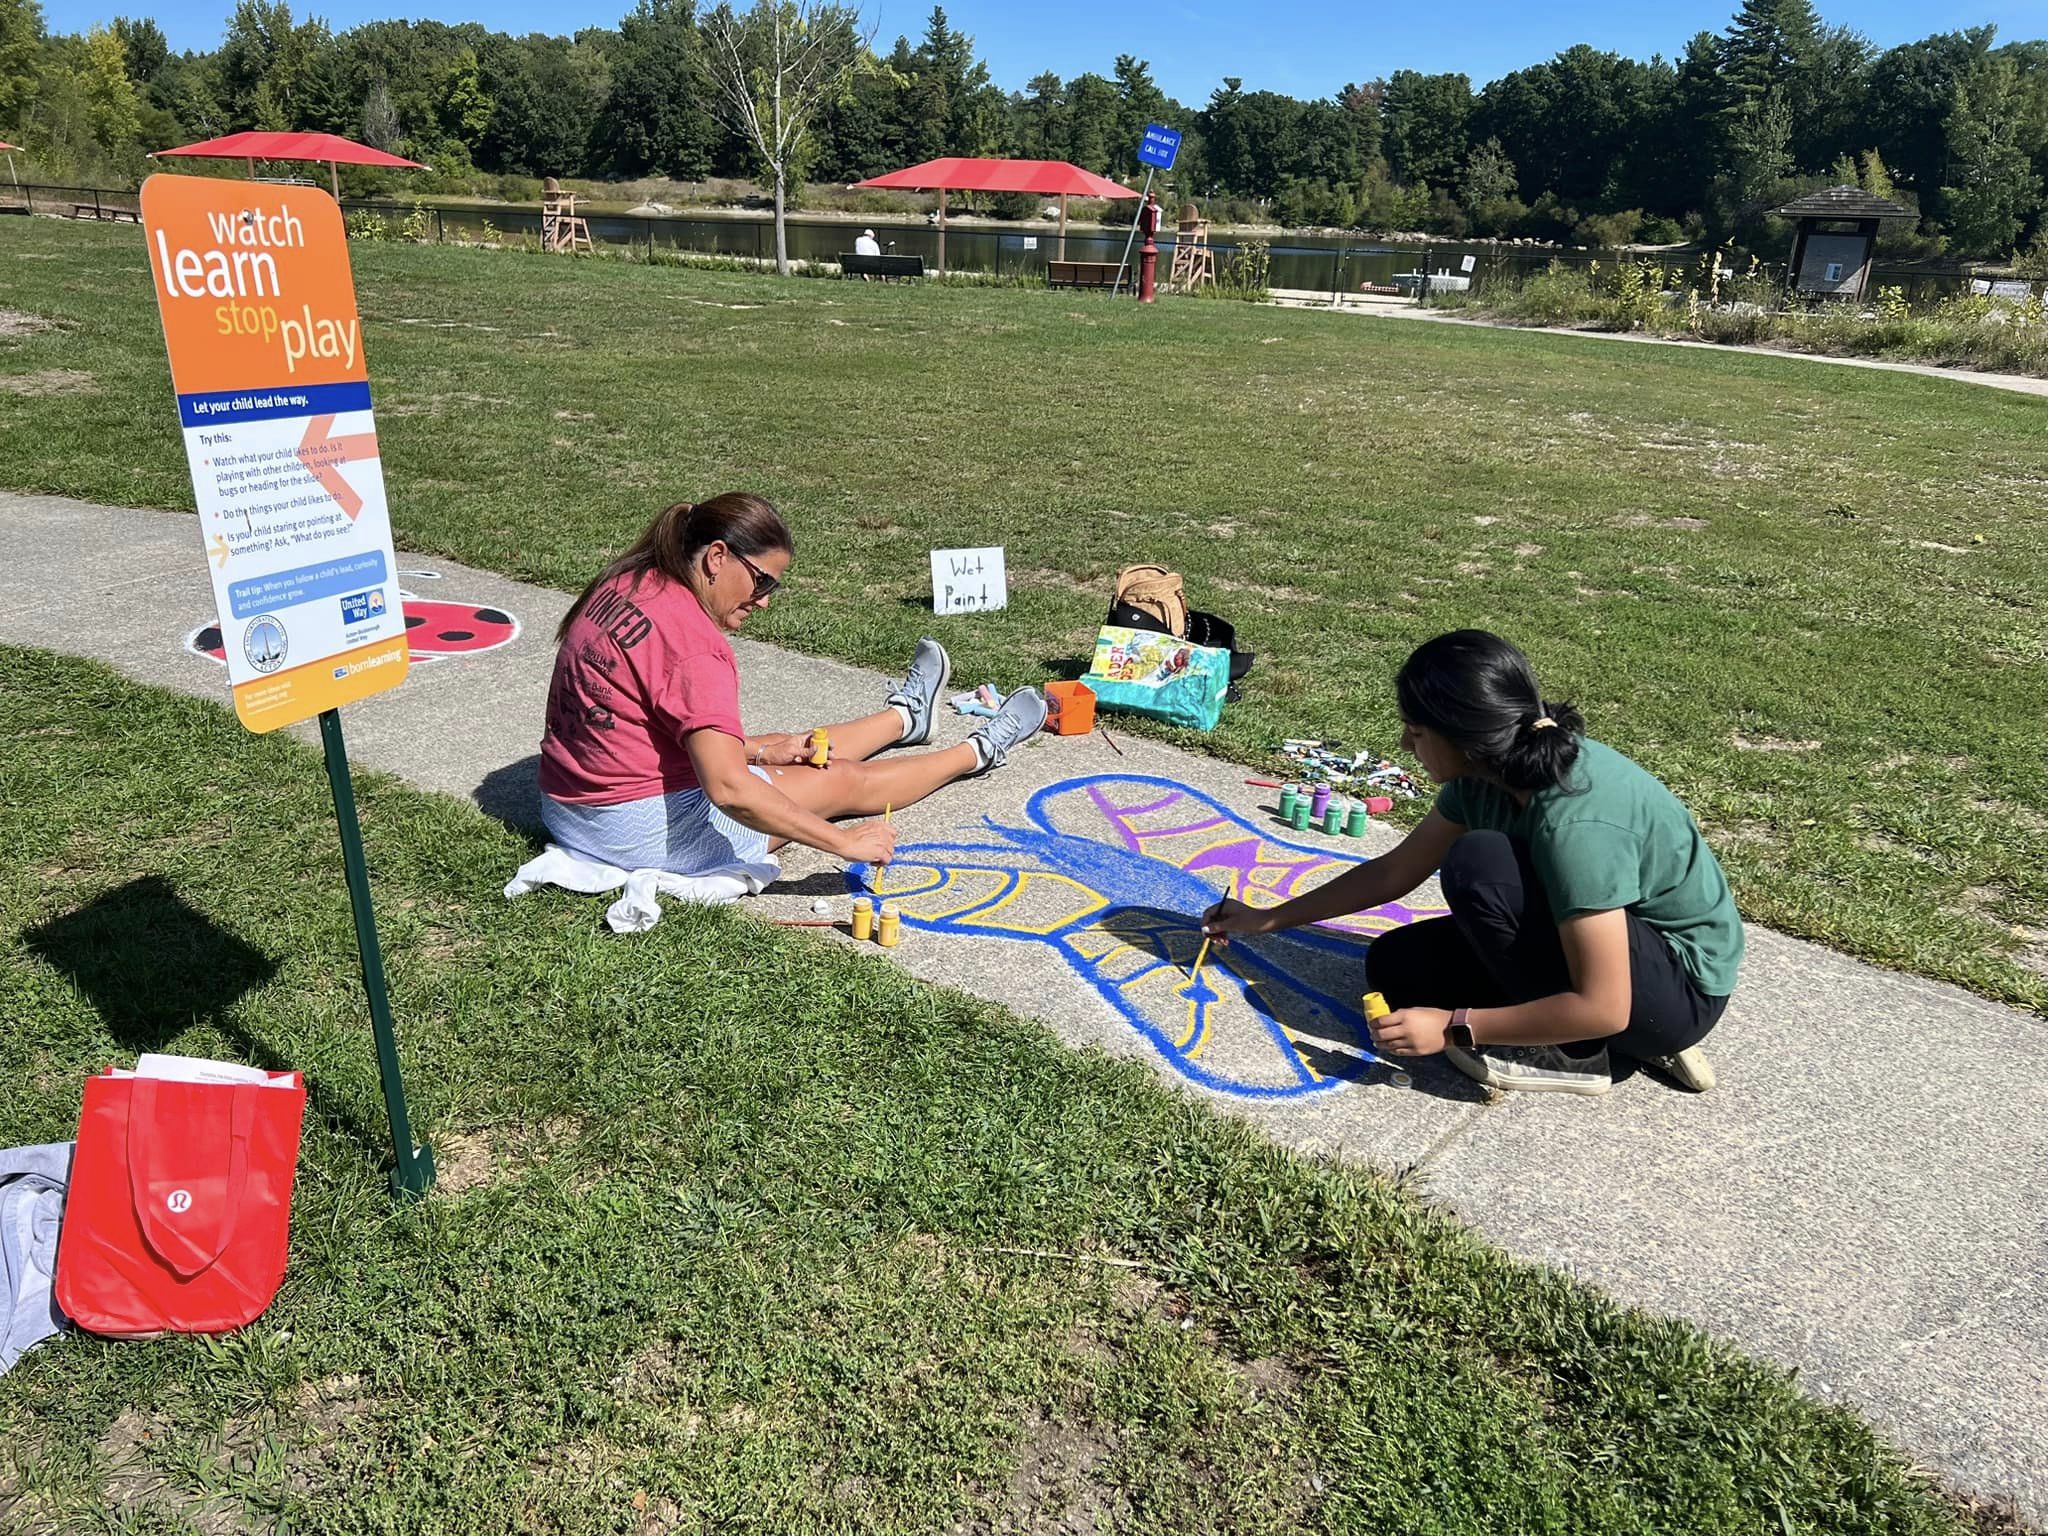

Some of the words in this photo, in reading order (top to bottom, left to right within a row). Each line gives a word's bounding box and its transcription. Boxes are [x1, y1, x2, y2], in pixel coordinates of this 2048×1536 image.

[1145, 144, 1157, 155] CALL
[207, 204, 304, 248] watch
[155, 229, 280, 298] learn
[215, 300, 278, 343] stop
[280, 304, 357, 374] play
[193, 401, 209, 414] Let
[210, 401, 230, 415] your
[231, 398, 253, 410] child
[254, 395, 273, 408] lead
[274, 394, 288, 406] the
[289, 395, 309, 407] way.
[199, 434, 213, 446] Try
[213, 432, 232, 443] this:
[212, 456, 236, 467] Watch
[238, 453, 257, 464] what
[257, 452, 274, 464] your
[275, 449, 293, 460] child
[293, 446, 310, 457] likes
[310, 445, 318, 454] to
[216, 470, 244, 484] playing
[245, 468, 261, 478] with
[262, 465, 282, 475] other
[283, 461, 313, 473] children,
[313, 457, 339, 468] looking
[339, 455, 346, 464] at
[218, 487, 238, 497] bugs
[240, 485, 248, 494] or
[249, 480, 279, 491] heading
[279, 478, 289, 487] for
[290, 475, 303, 486] the
[223, 509, 234, 520] Do
[249, 504, 273, 515] things
[273, 502, 289, 513] your
[290, 498, 307, 508] child
[308, 495, 324, 504] likes
[324, 493, 332, 502] to
[227, 532, 235, 542] Is
[254, 526, 272, 537] child
[273, 522, 297, 535] staring
[298, 520, 305, 528] or
[306, 515, 334, 529] pointing
[335, 513, 342, 522] at
[230, 539, 273, 556] something?
[274, 537, 290, 548] Ask,
[313, 530, 321, 539] do
[321, 528, 335, 539] you
[950, 555, 984, 576] Wet
[235, 588, 250, 598] Trail
[263, 581, 282, 592] When
[283, 579, 295, 589] you
[295, 574, 314, 585] follow
[945, 583, 988, 608] Paint
[237, 601, 251, 610] and
[252, 593, 286, 607] confidence
[341, 595, 366, 610] United
[352, 607, 368, 618] Way
[585, 587, 652, 649] UNITED
[348, 649, 402, 674] bornlearning
[1107, 646, 1125, 677] ADER
